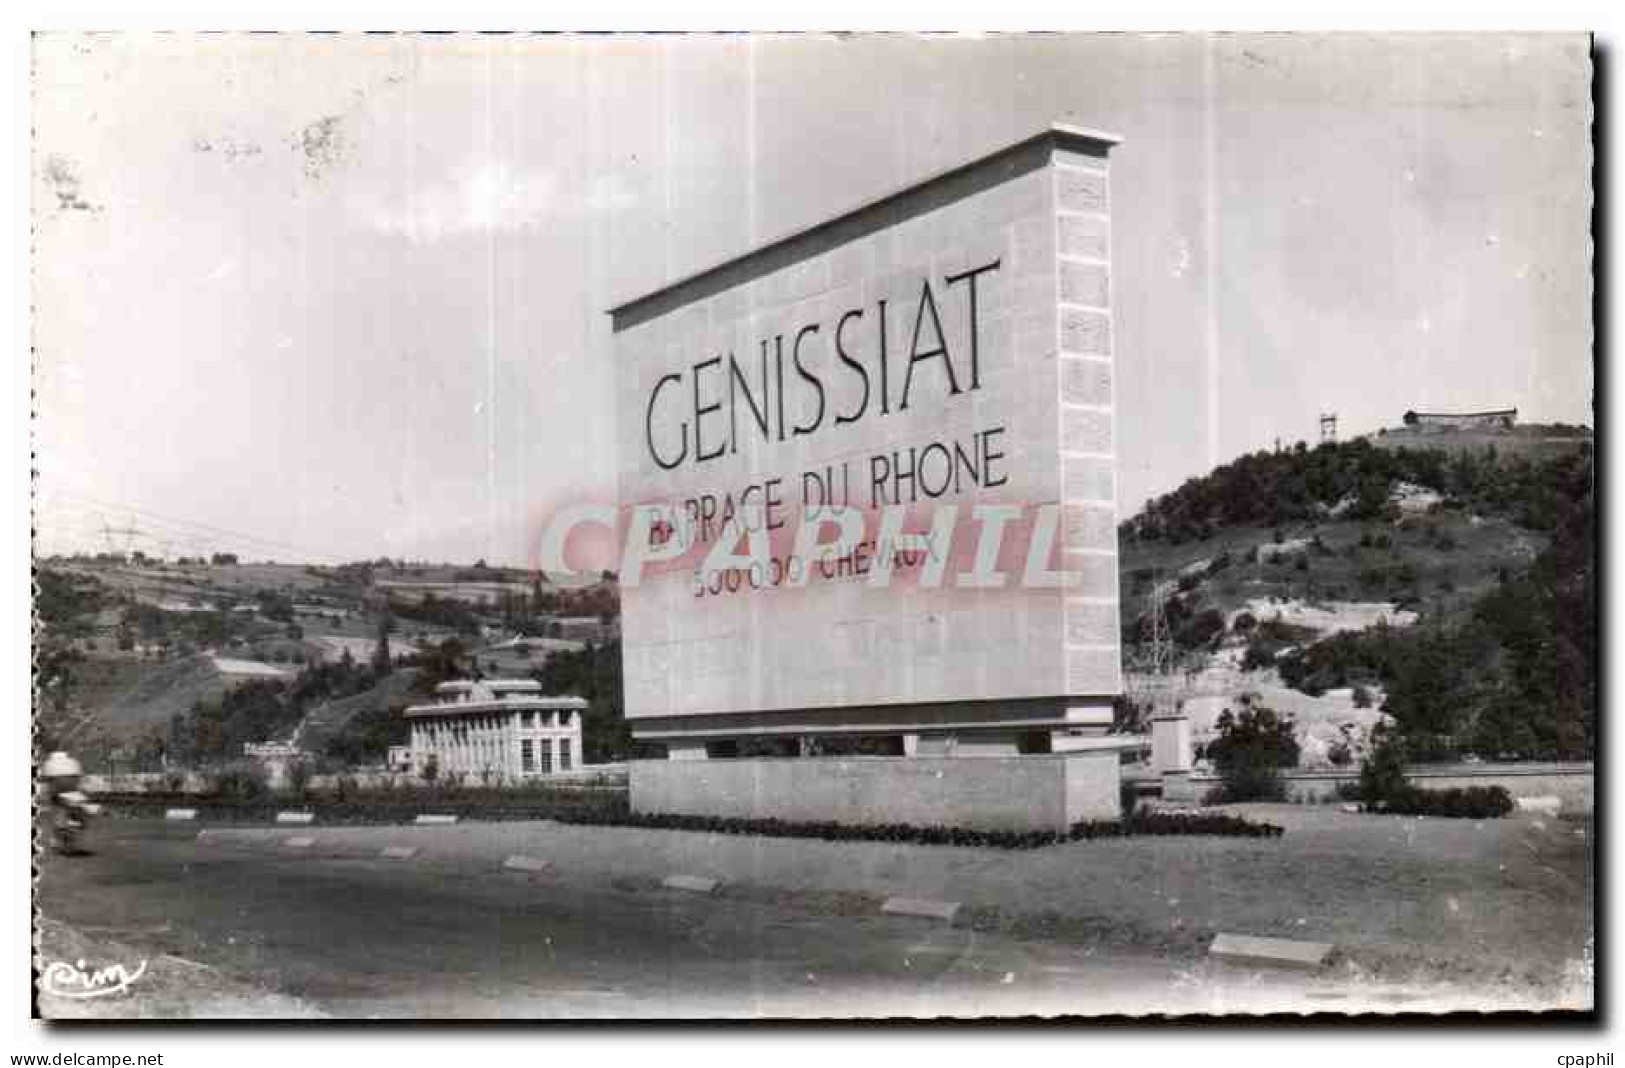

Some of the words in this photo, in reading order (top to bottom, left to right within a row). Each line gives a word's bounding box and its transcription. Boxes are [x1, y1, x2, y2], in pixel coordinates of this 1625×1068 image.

[646, 258, 1001, 470] GENISSIAT
[802, 463, 848, 522] DU
[870, 427, 1008, 510] RHONE
